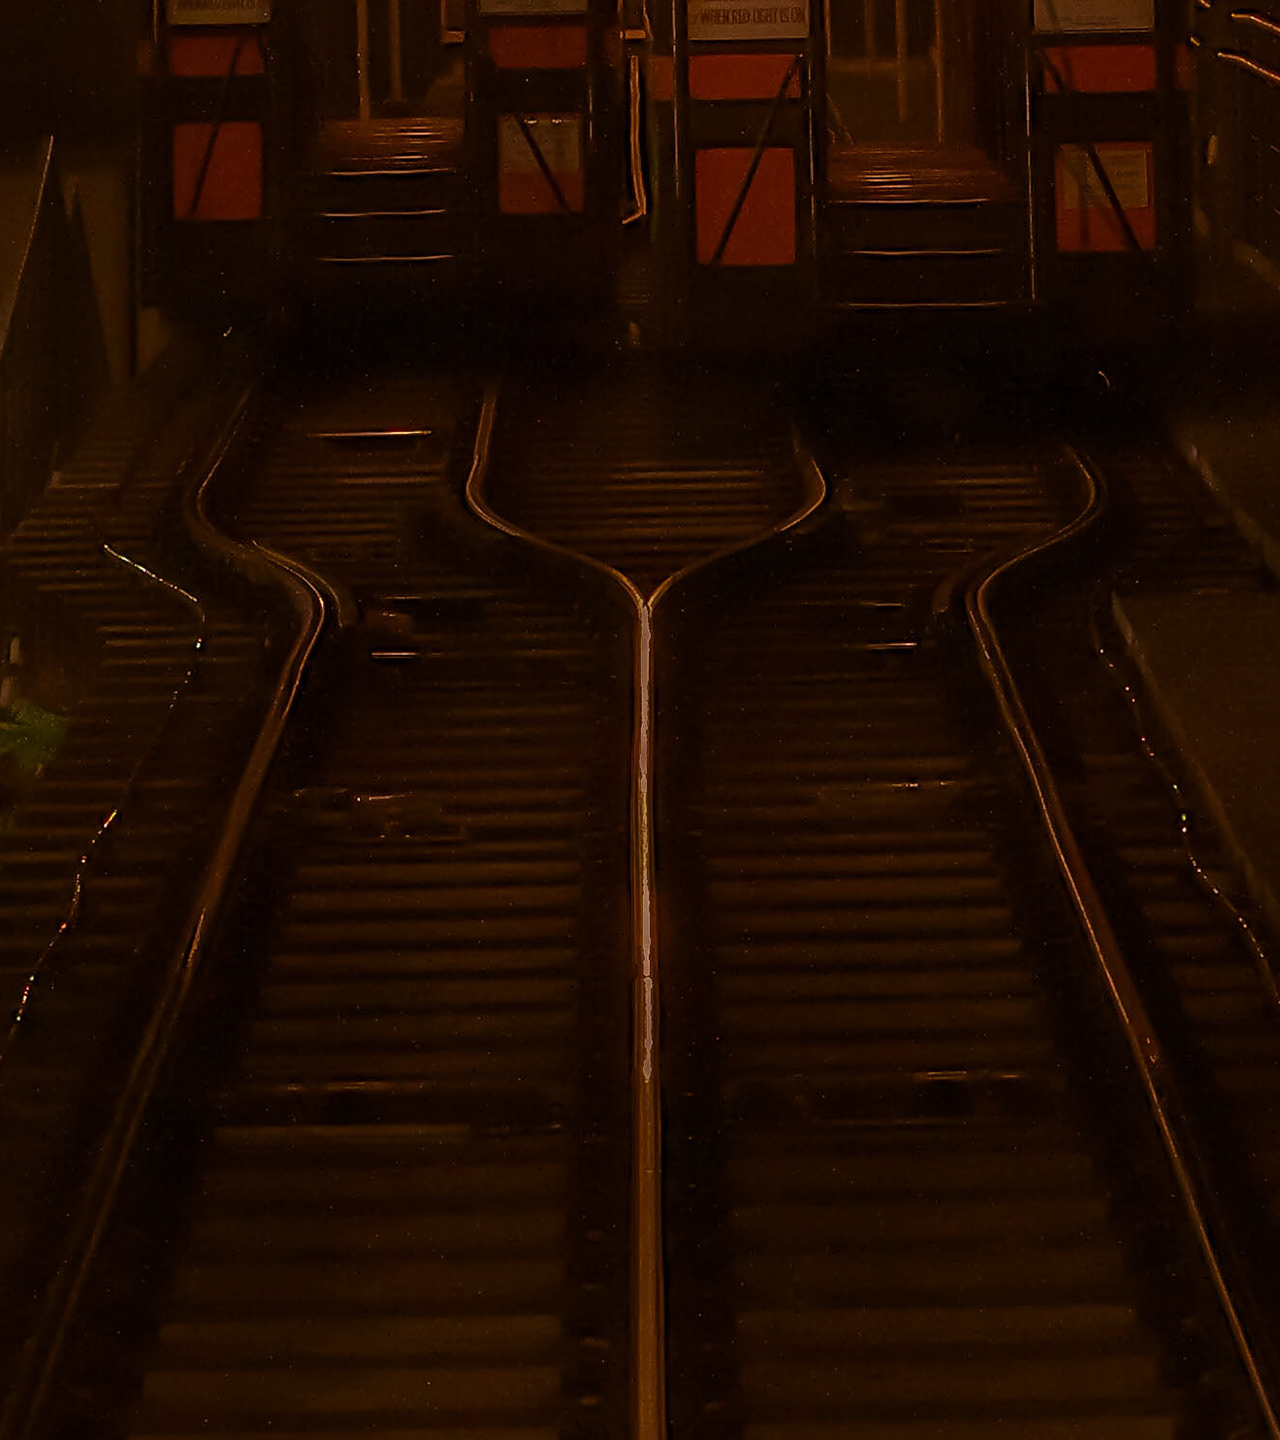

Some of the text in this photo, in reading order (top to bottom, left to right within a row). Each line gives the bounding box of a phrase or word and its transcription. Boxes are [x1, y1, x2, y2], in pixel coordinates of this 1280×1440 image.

[700, 9, 730, 25] WHEN
[732, 8, 751, 24] RED
[780, 7, 789, 23] IS
